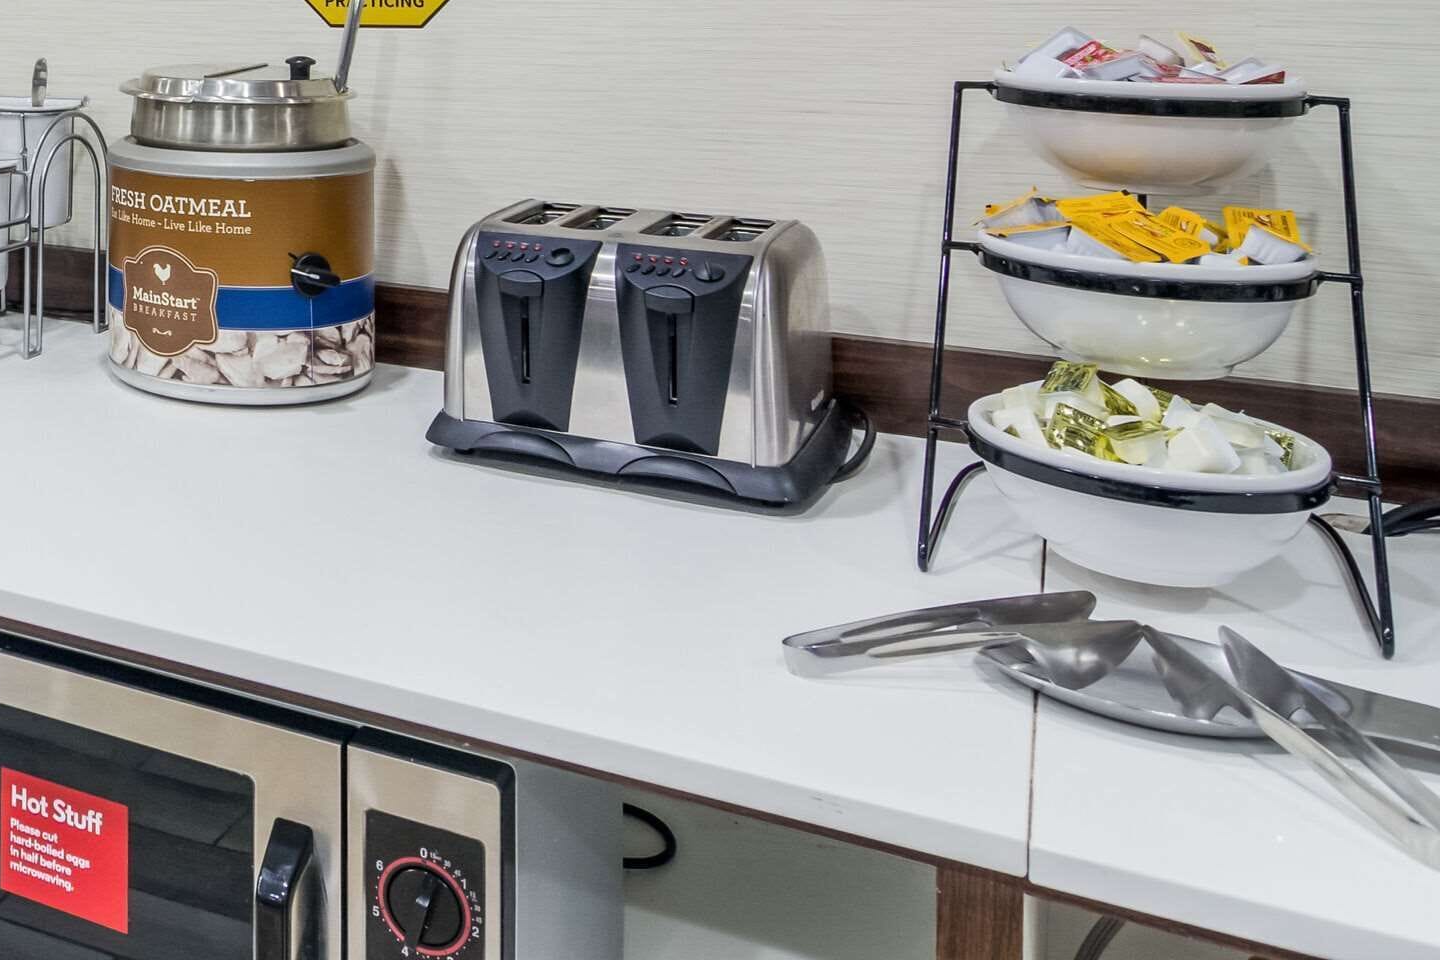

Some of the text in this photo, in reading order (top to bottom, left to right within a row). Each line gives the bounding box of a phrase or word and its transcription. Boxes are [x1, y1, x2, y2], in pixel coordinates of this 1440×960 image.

[111, 185, 252, 218] FRESH OATMEAL
[131, 213, 156, 228] Home
[163, 218, 186, 231] Live
[188, 221, 213, 234] Like
[215, 223, 252, 235] Home
[133, 302, 197, 322] BREAKFAST
[11, 784, 103, 835] Hot Stuff
[10, 817, 58, 844] Please cut
[10, 831, 90, 869] hard-boiled eggs
[10, 845, 72, 876] in half before
[420, 847, 428, 859] 0
[376, 860, 384, 871] 6
[10, 861, 74, 892] microwaving.
[460, 878, 467, 890] 1
[372, 905, 380, 917] 5
[472, 926, 480, 938] 2
[401, 945, 409, 957] 4
